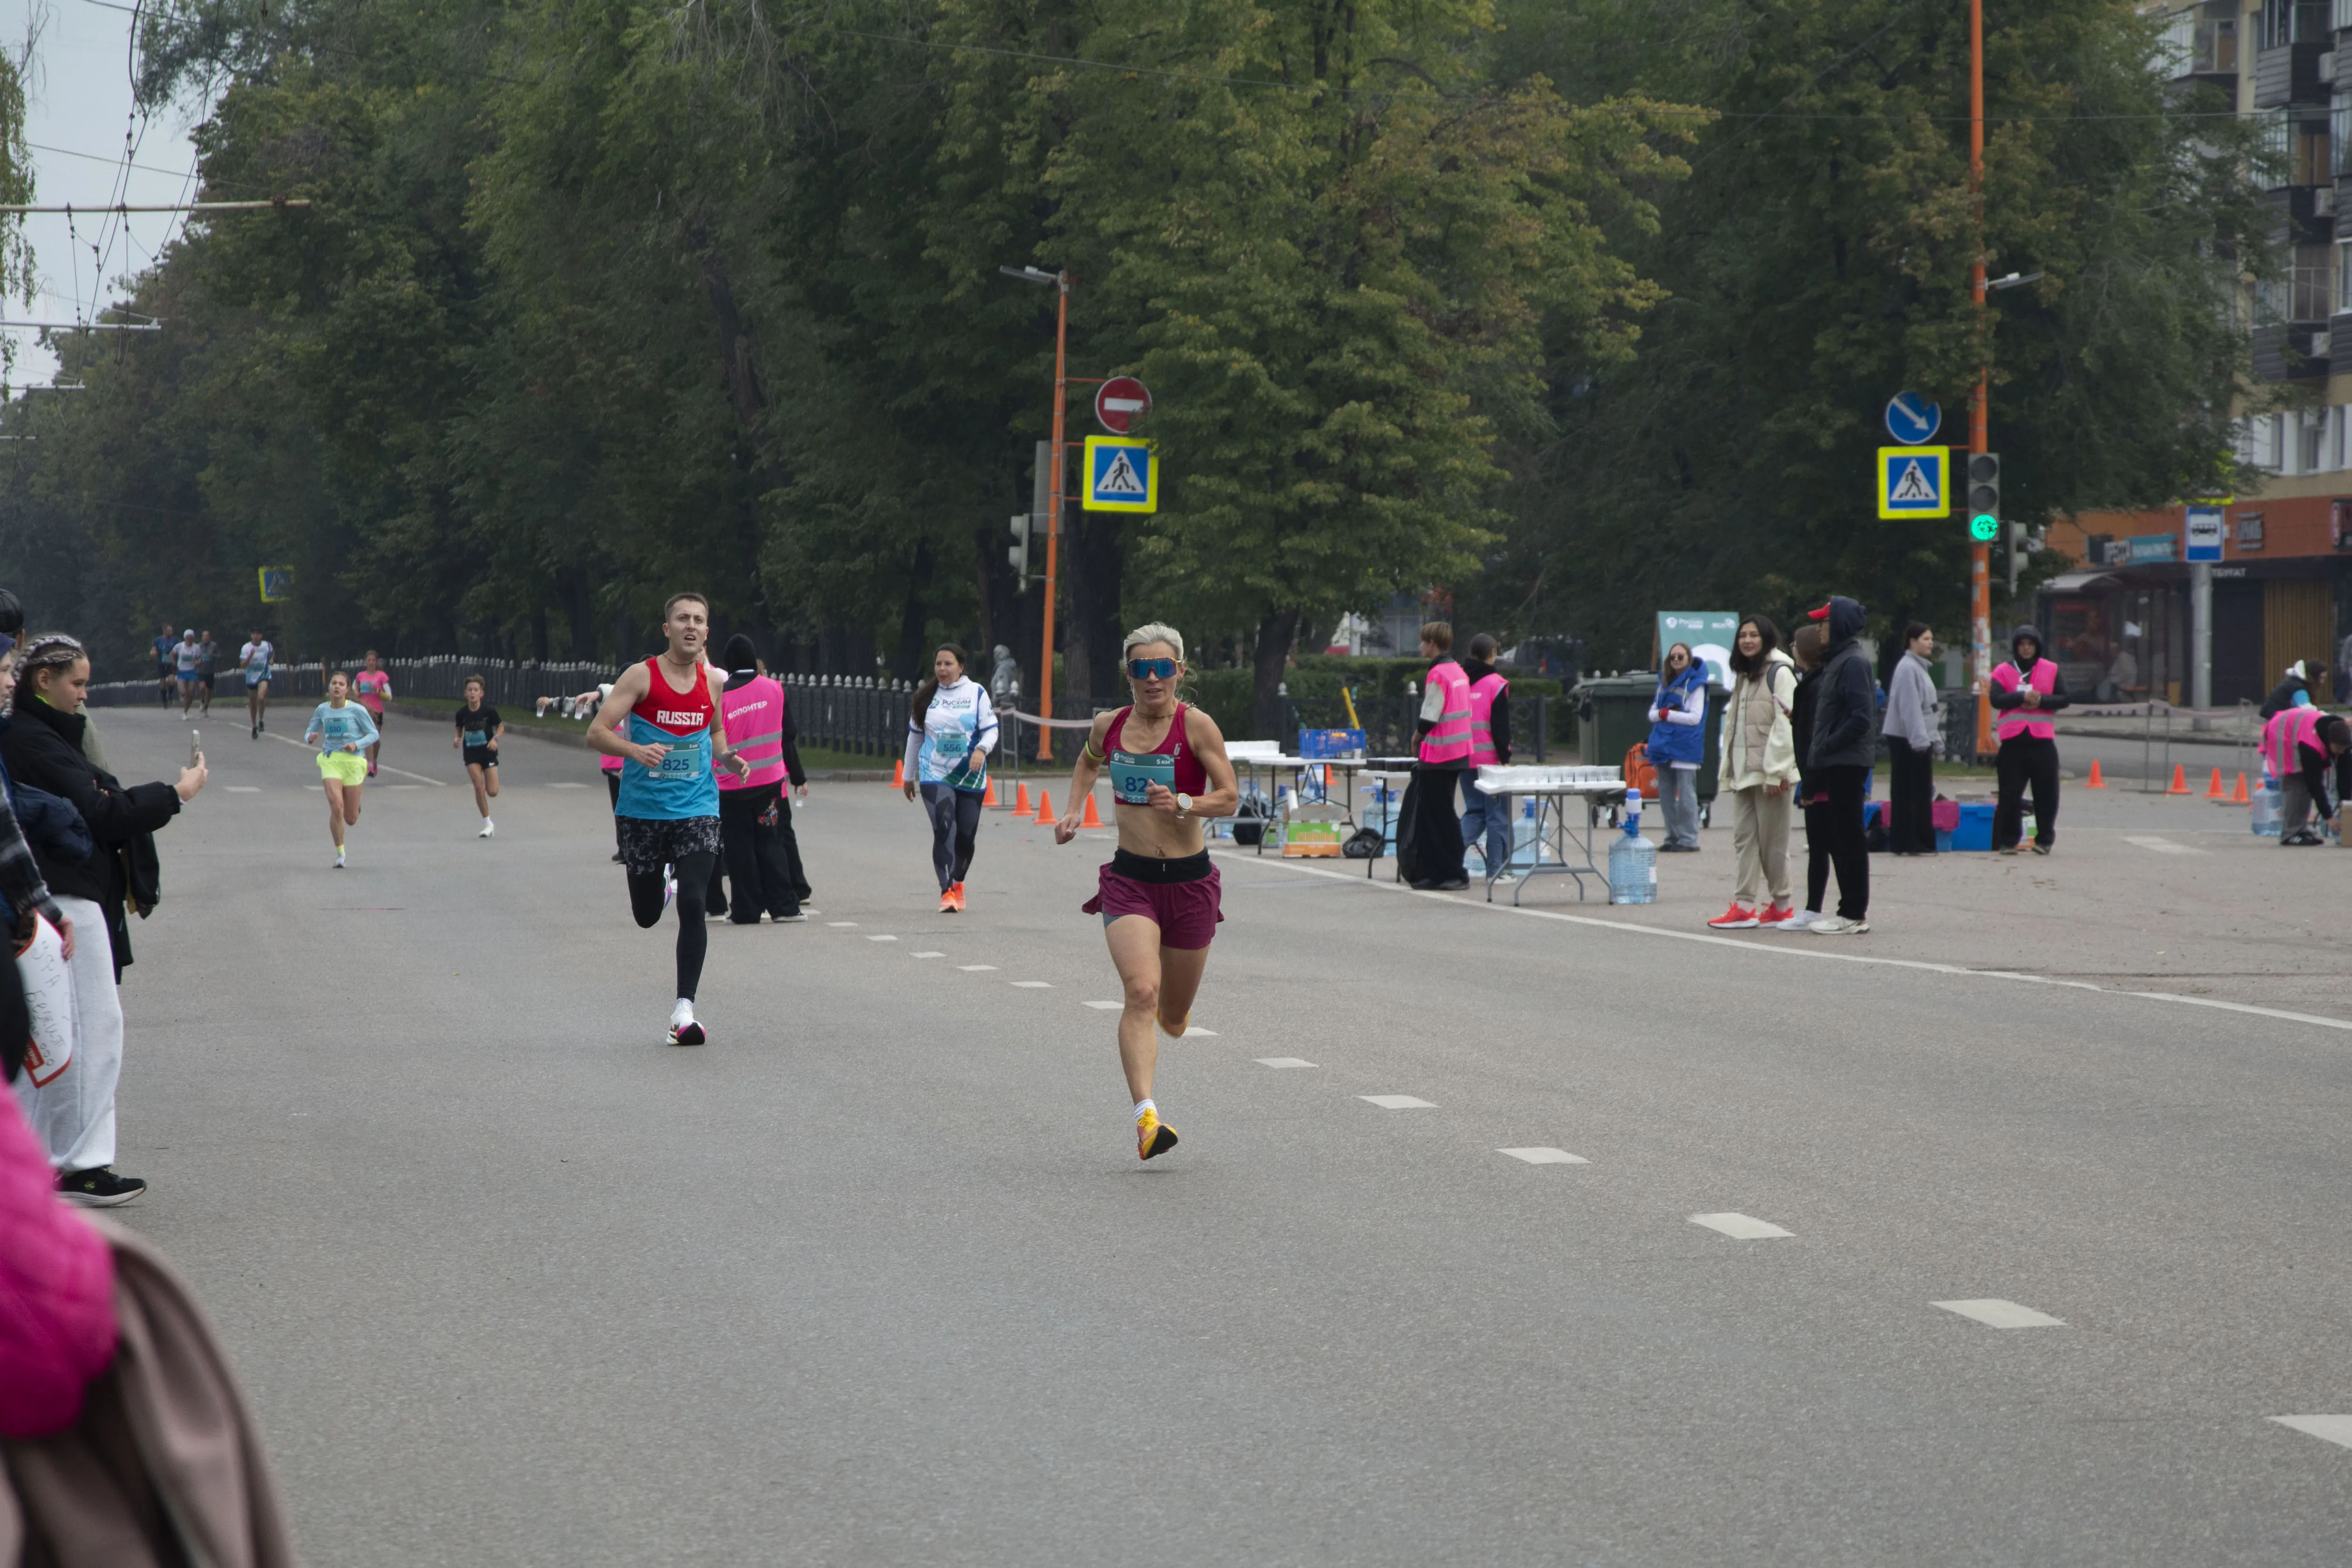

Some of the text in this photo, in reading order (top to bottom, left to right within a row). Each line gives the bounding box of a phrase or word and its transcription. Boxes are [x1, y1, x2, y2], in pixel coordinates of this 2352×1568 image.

[657, 710, 704, 726] RUSSIA
[727, 700, 767, 720] ВОЛОНТЕР
[662, 758, 689, 771] 825
[1125, 776, 1155, 792] 82
